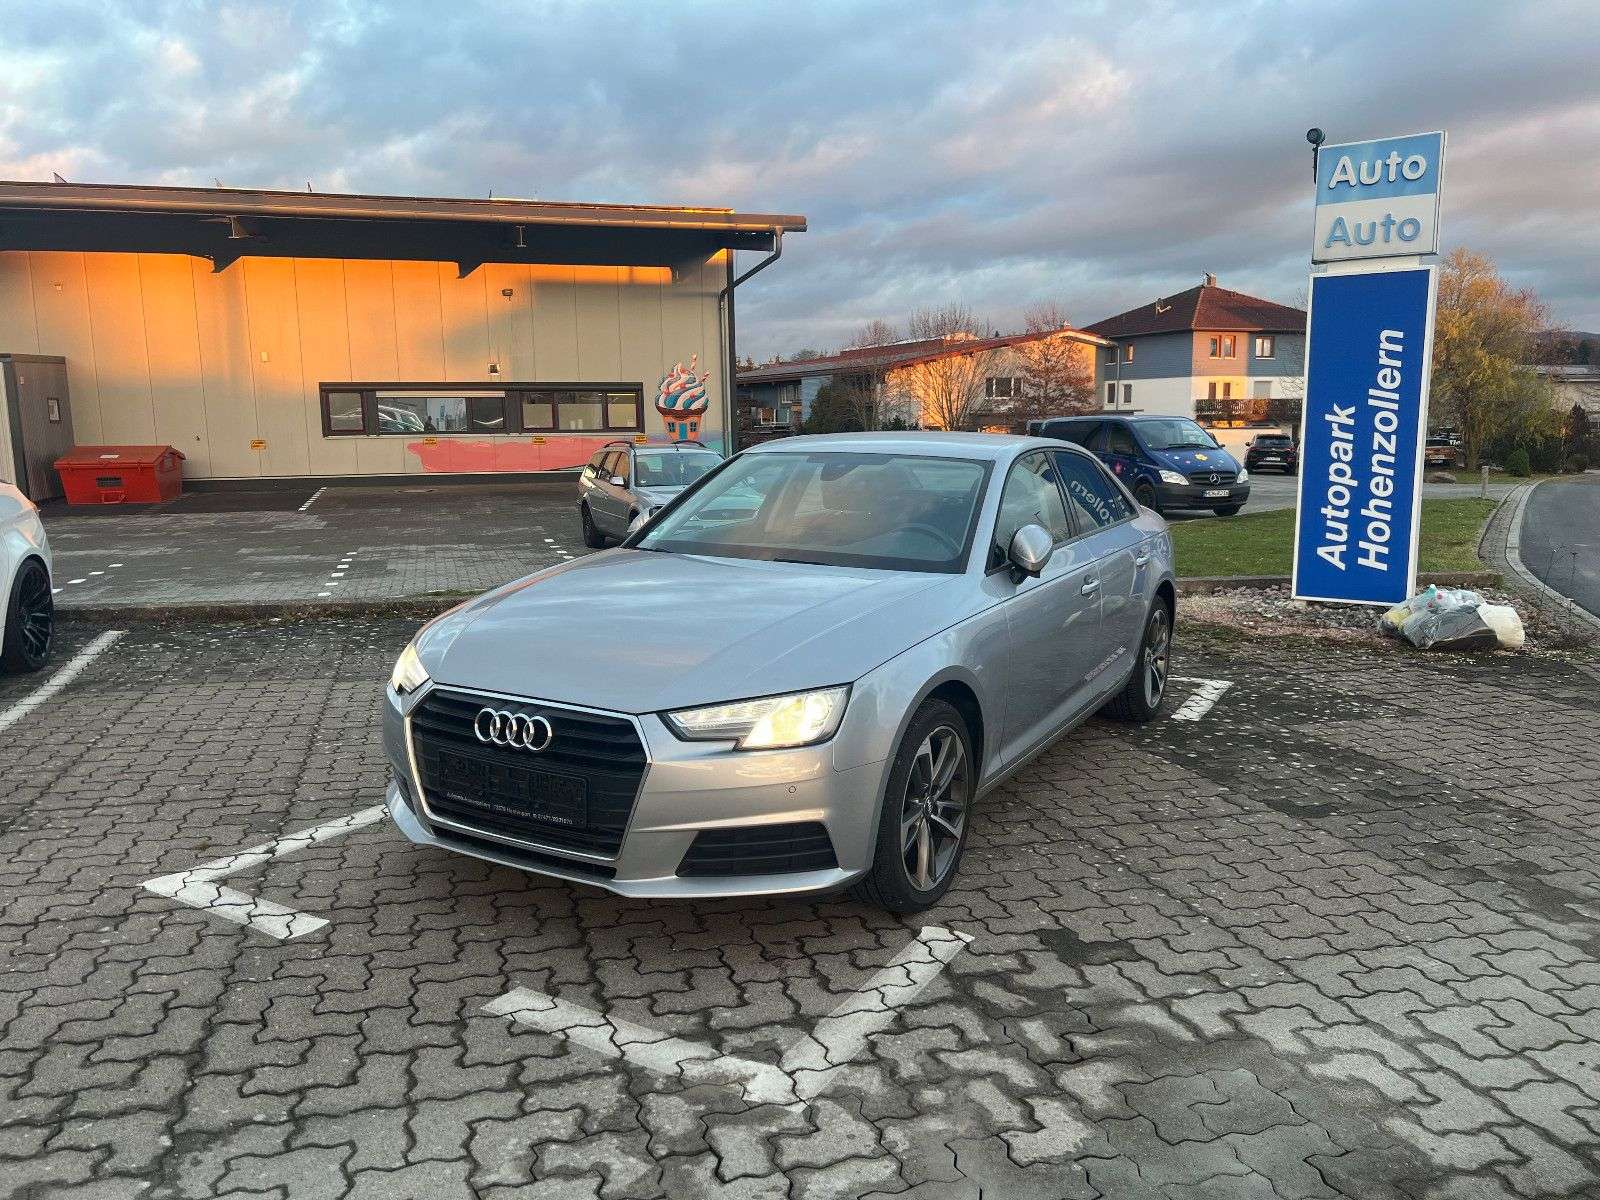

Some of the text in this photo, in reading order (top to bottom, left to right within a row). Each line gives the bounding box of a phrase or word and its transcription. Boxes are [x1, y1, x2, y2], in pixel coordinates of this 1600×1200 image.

[1328, 151, 1427, 190] Auto
[1325, 213, 1421, 248] Auto
[1316, 402, 1358, 571] Autopark
[1357, 329, 1404, 571] Hohenzollern
